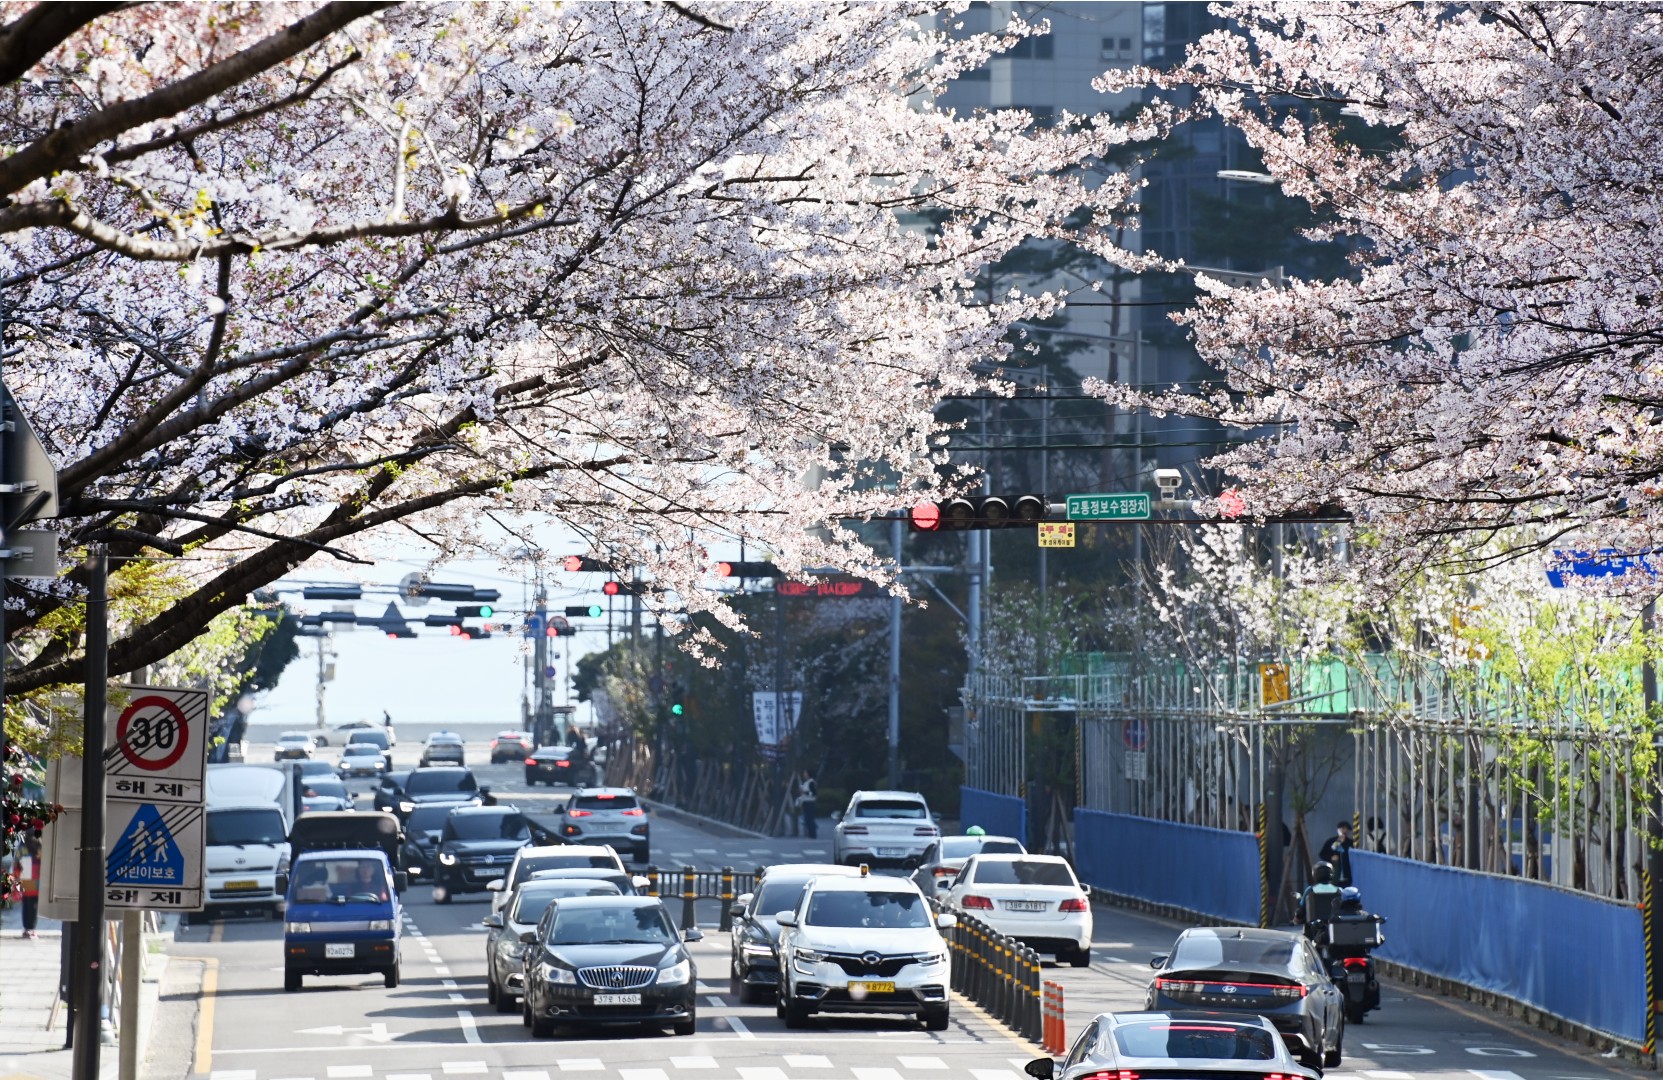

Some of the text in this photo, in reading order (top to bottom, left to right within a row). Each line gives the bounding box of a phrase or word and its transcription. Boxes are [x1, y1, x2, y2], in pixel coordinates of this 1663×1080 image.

[1071, 499, 1147, 515] 교통정보수집장치
[132, 717, 175, 749] 30
[116, 865, 176, 880] 어린이보호
[872, 983, 892, 991] 8772
[617, 994, 637, 1003] 1660
[1361, 1043, 1538, 1057] 50
